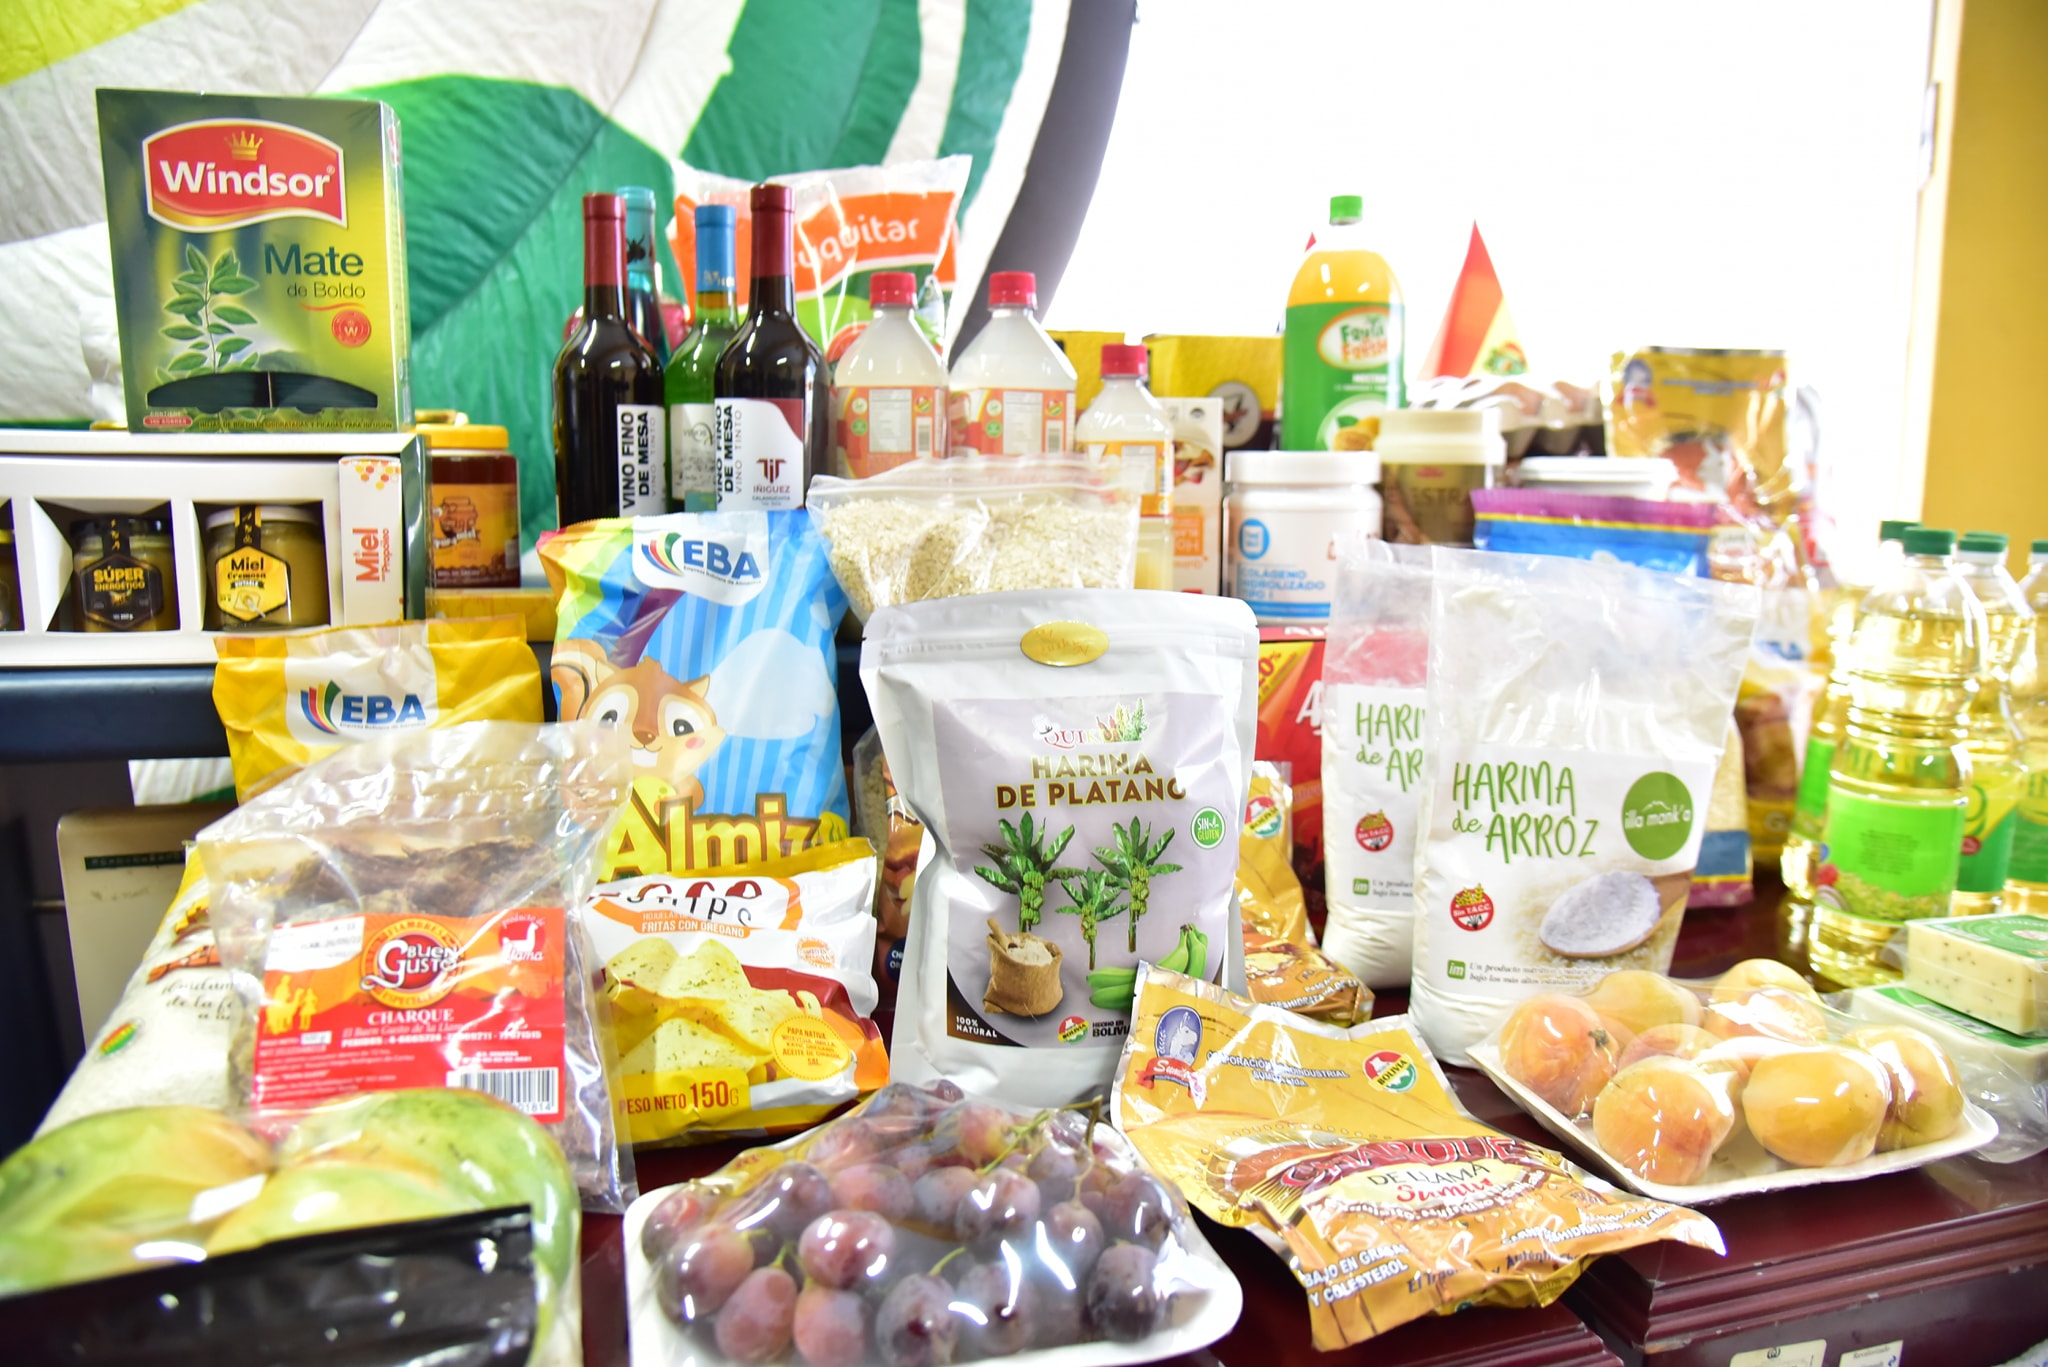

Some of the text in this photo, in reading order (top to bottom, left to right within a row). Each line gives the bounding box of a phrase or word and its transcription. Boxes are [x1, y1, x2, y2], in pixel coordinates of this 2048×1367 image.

[160, 161, 331, 197] Windsor
[264, 243, 363, 276] Mate
[287, 281, 365, 299] de Boldo
[621, 411, 635, 509] VINO FINO
[638, 411, 650, 496] DE MESA
[723, 405, 734, 493] DE MESA
[231, 557, 264, 571] Miel
[352, 528, 380, 582] Miel
[683, 540, 761, 579] EBA
[93, 566, 144, 583] SÚPER
[341, 694, 426, 723] EBA
[1031, 752, 1154, 780] HARINA
[1356, 744, 1382, 766] de
[996, 776, 1187, 809] DE PLATANO
[1453, 760, 1577, 816] HARINA
[1197, 817, 1209, 831] SIN
[1452, 810, 1599, 864] de ARROZ
[642, 920, 676, 933] FRITAS
[678, 920, 698, 931] CON
[1453, 908, 1466, 918] Sin
[361, 939, 459, 990] GUSTO
[368, 1009, 454, 1025] CHARQUE
[956, 1016, 978, 1027] 100%
[956, 1024, 998, 1038] NATURAL
[787, 1026, 826, 1039] PAPA NATIVA
[1376, 1059, 1408, 1086] BOLIVIA
[619, 1093, 687, 1116] PESO NETO
[1367, 1160, 1491, 1186] DE LLAMA
[1304, 1263, 1339, 1289] BAJO
[1340, 1256, 1358, 1272] EN
[1308, 1291, 1321, 1308] Y
[1323, 1258, 1409, 1304] COLESTEROL
